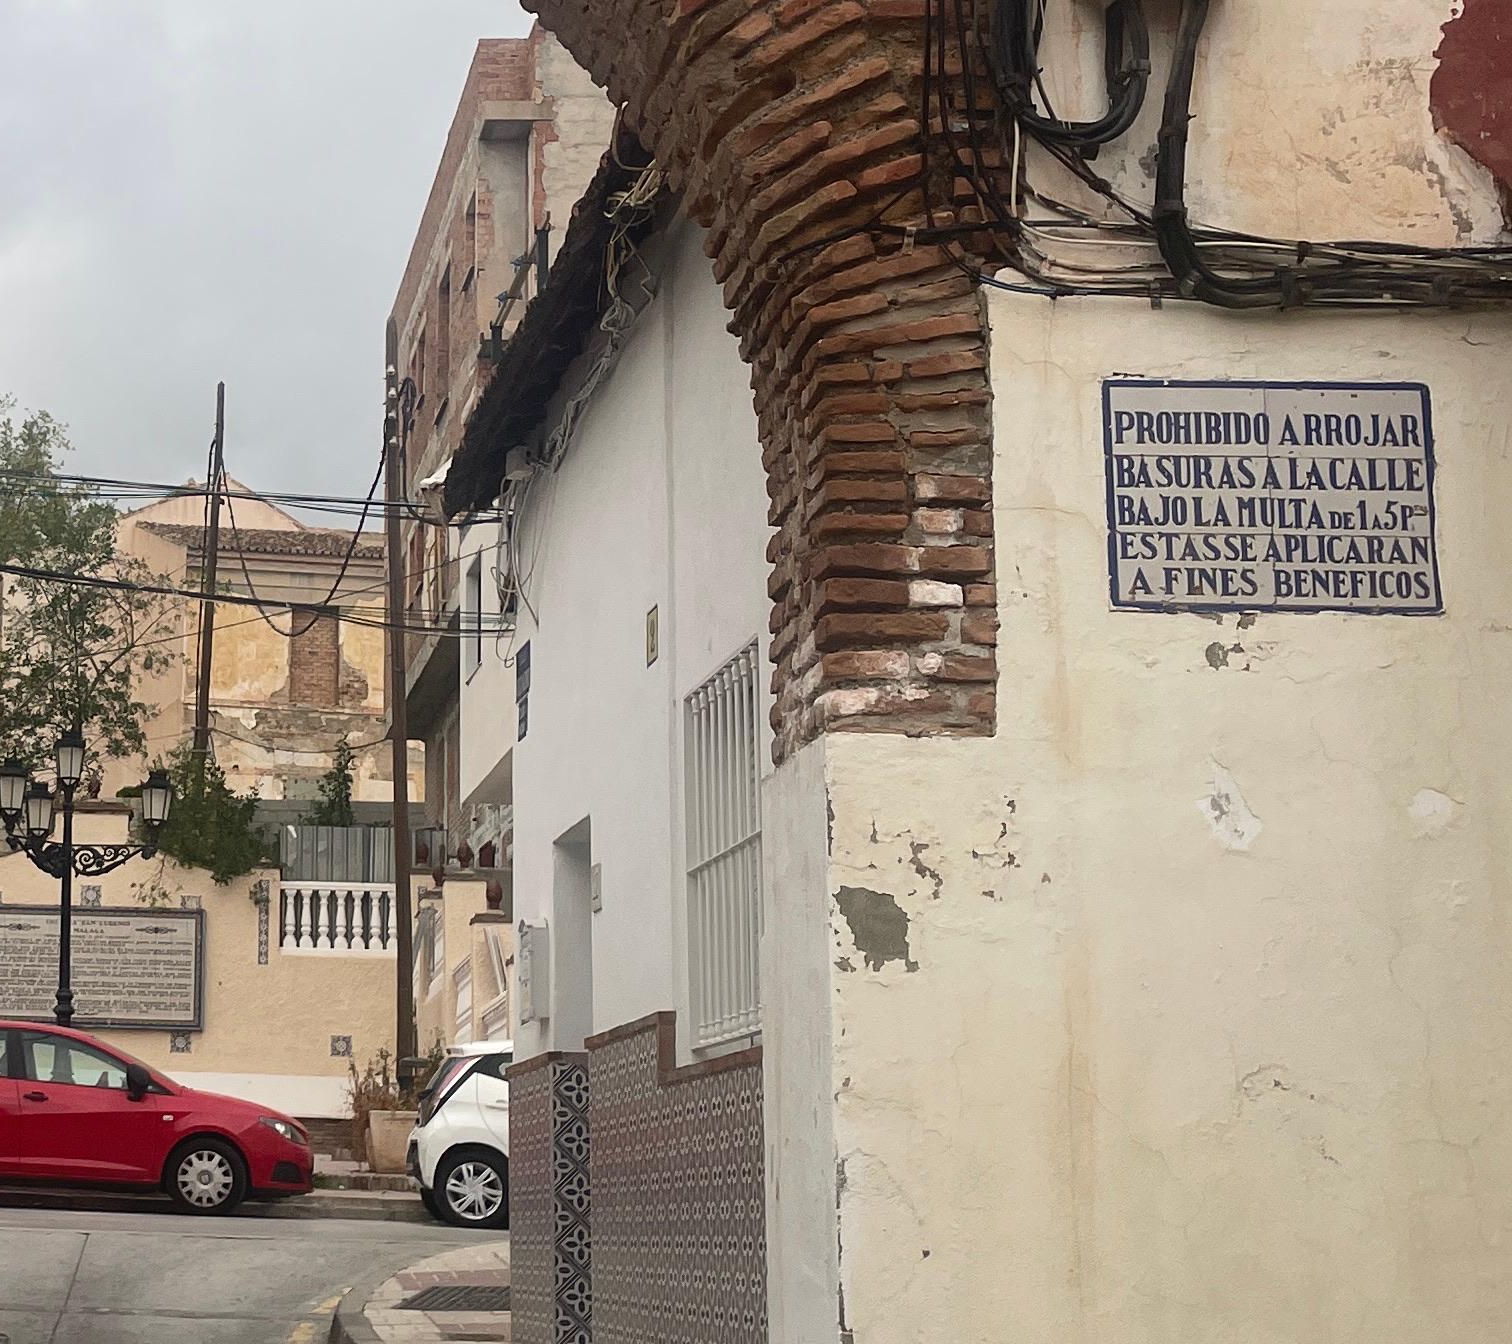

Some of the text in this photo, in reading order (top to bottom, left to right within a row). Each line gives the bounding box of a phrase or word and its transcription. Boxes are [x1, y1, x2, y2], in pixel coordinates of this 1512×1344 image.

[1114, 411, 1422, 447] PROHIBIDO ARROJAR
[1116, 455, 1425, 491] BASURAS A LA CALLE
[1117, 494, 1188, 526] BAJO
[1192, 495, 1232, 527] LA
[1236, 496, 1326, 530] MULTA
[1328, 511, 1356, 530] DE
[1356, 500, 1368, 530] 1
[1371, 513, 1385, 530] A
[1383, 500, 1399, 531] 5
[1120, 532, 1430, 564] ESTAS SE APLICARAN
[1128, 567, 1431, 599] A FINES BENEFICOS
